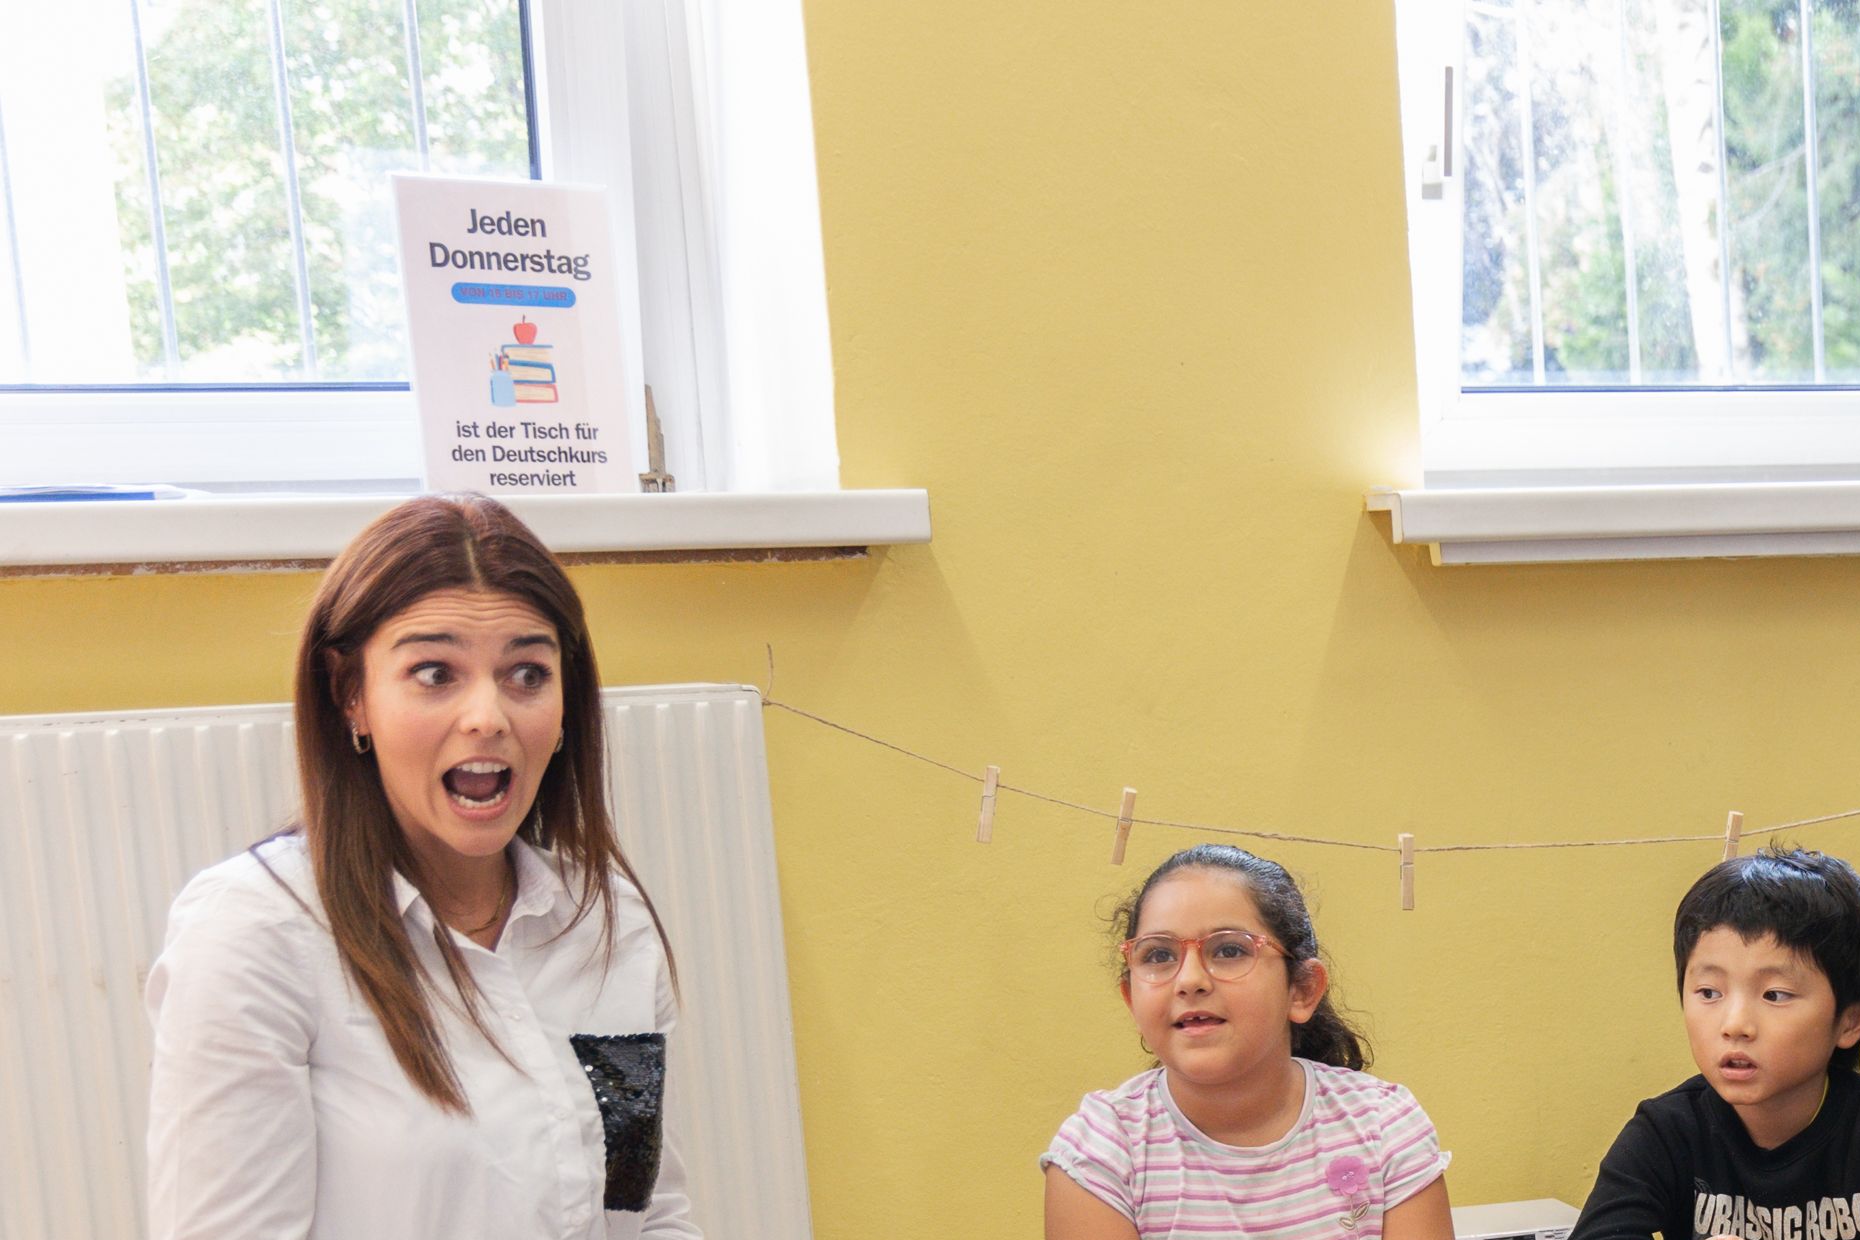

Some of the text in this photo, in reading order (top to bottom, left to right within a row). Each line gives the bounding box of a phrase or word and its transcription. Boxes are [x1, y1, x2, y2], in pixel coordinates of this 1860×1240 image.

[466, 208, 547, 237] Jeden
[429, 242, 592, 280] Donnerstag
[460, 287, 485, 298] VON
[505, 289, 523, 299] BIS
[544, 291, 567, 301] UHR
[456, 421, 599, 440] ist der Tisch für
[452, 445, 608, 464] den Deutschkurs
[489, 470, 576, 487] reserviert
